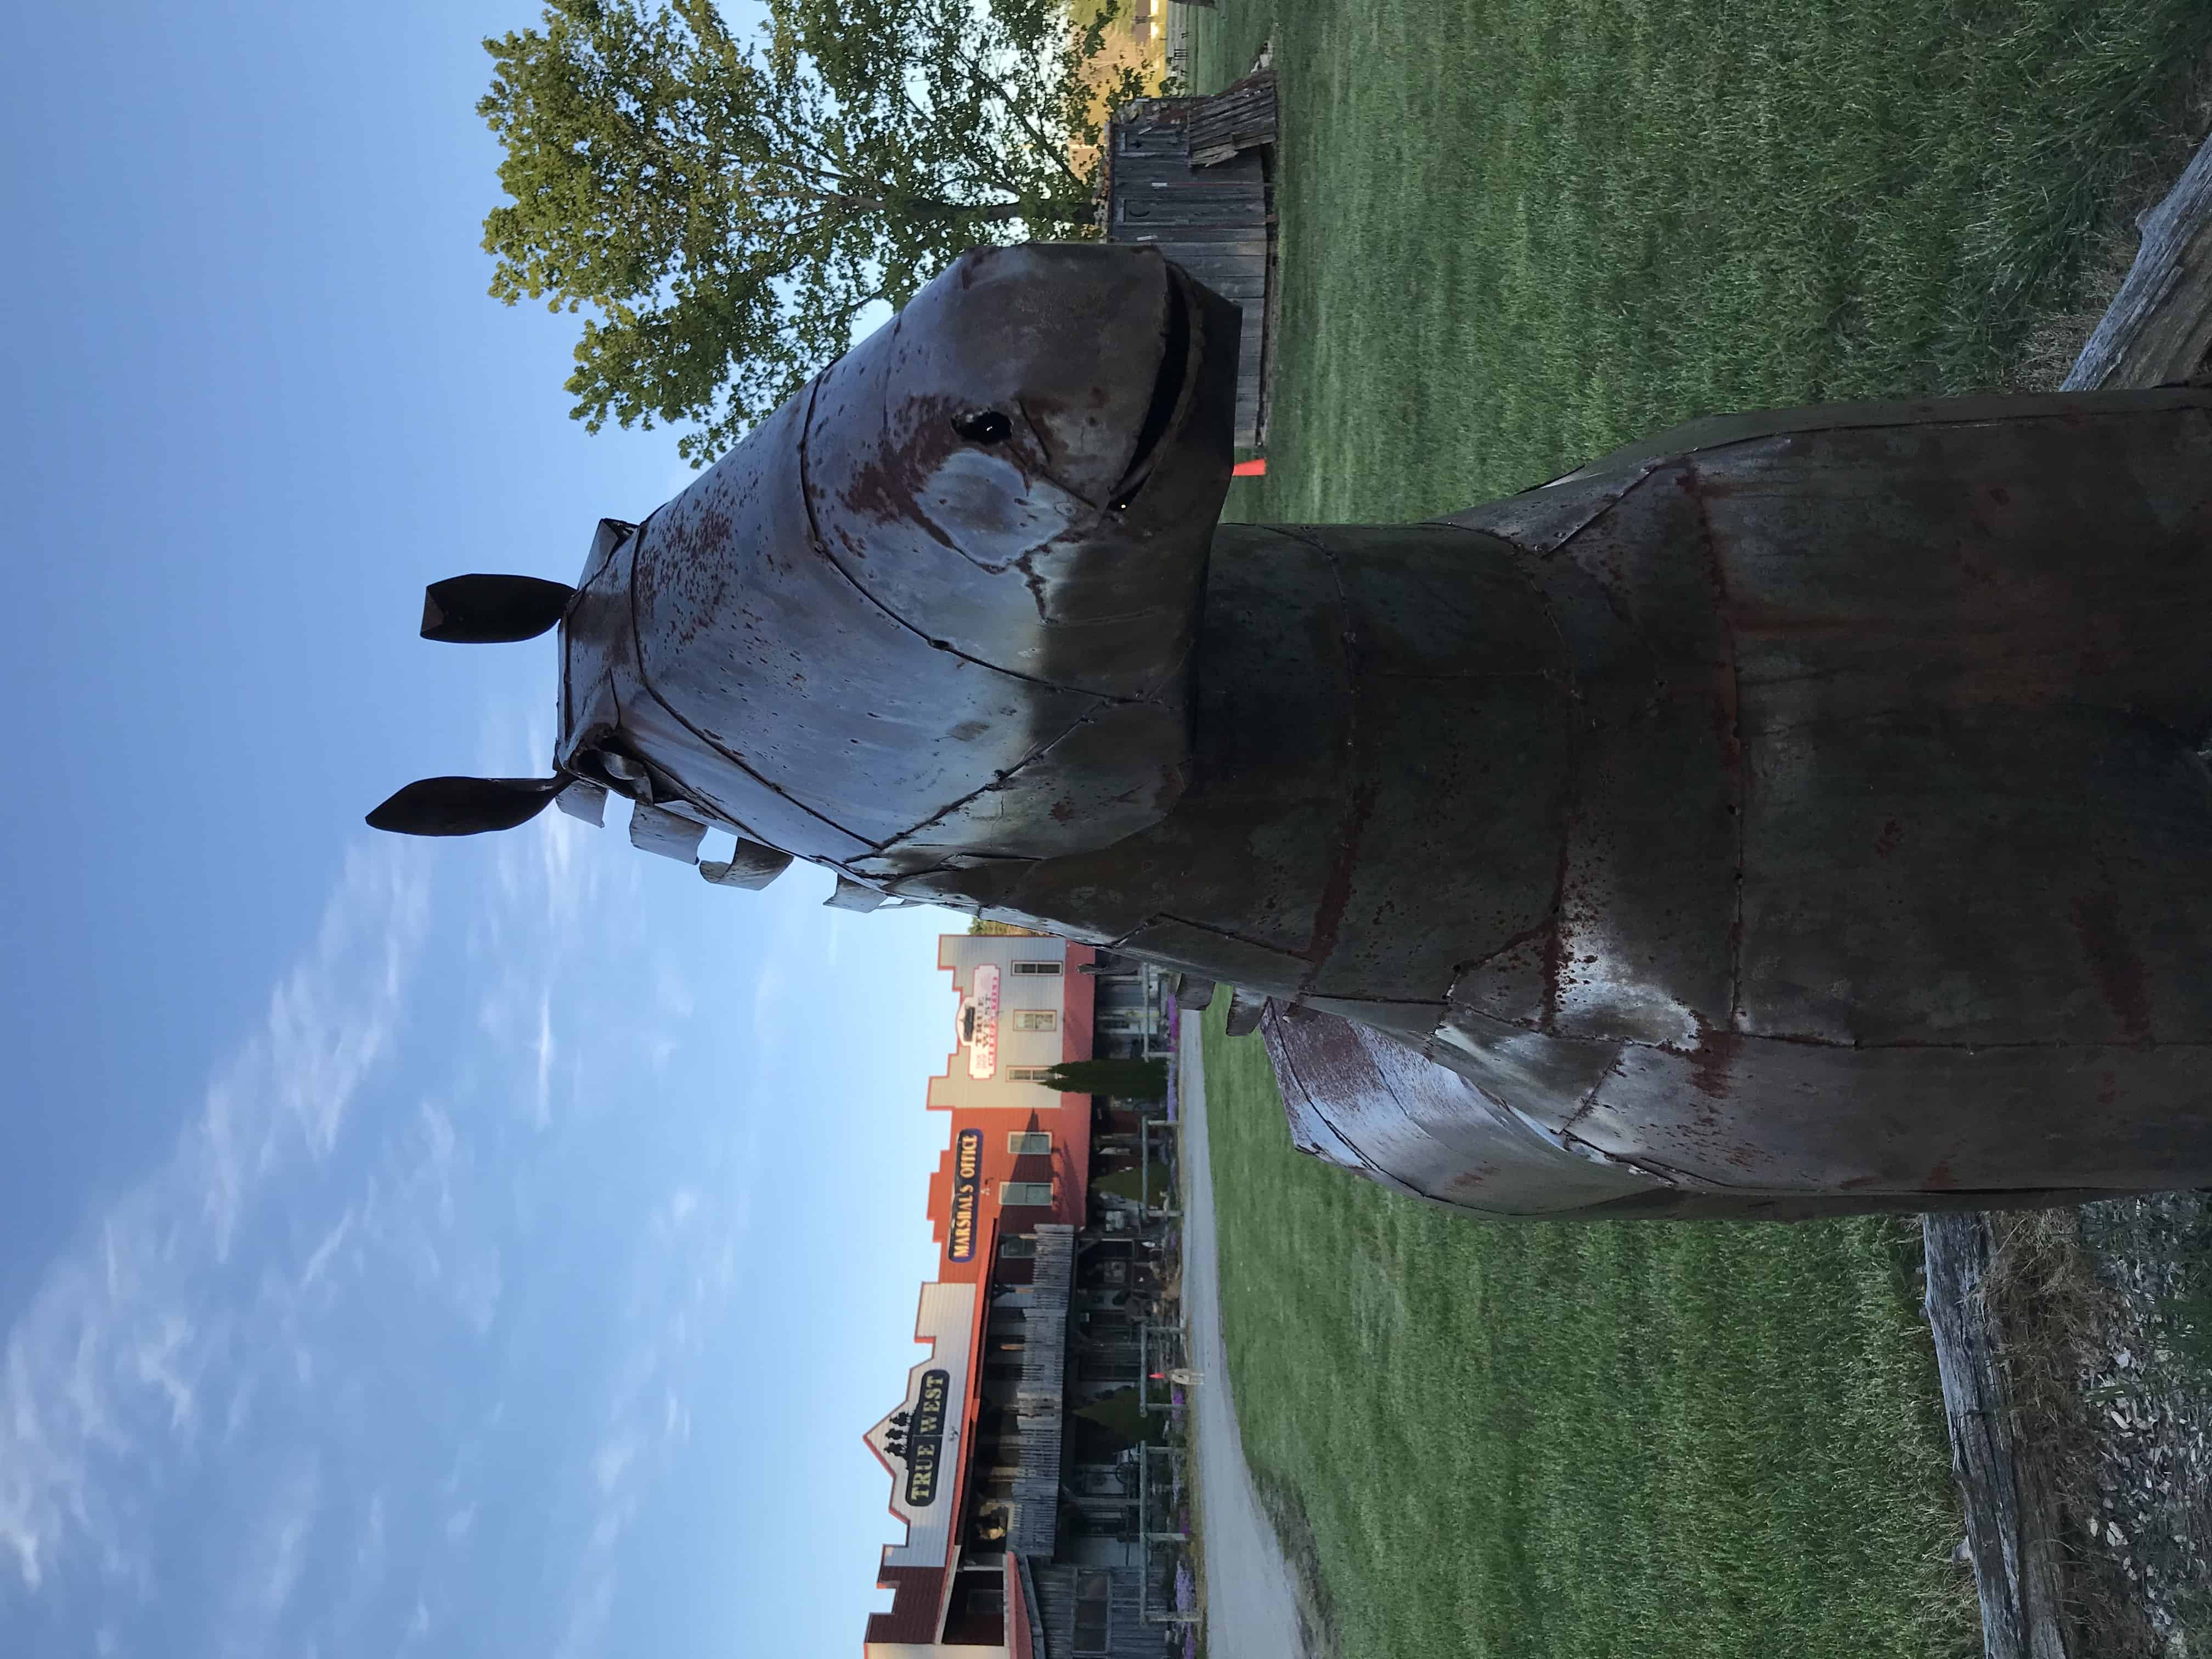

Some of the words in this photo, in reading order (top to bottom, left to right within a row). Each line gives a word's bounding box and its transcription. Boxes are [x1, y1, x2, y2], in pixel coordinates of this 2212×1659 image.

[975, 996, 984, 1047] TRUE
[983, 993, 991, 1048] WEST
[960, 1135, 978, 1178] OFFICE
[920, 1375, 943, 1434] WEST
[911, 1444, 935, 1500] TRUE
